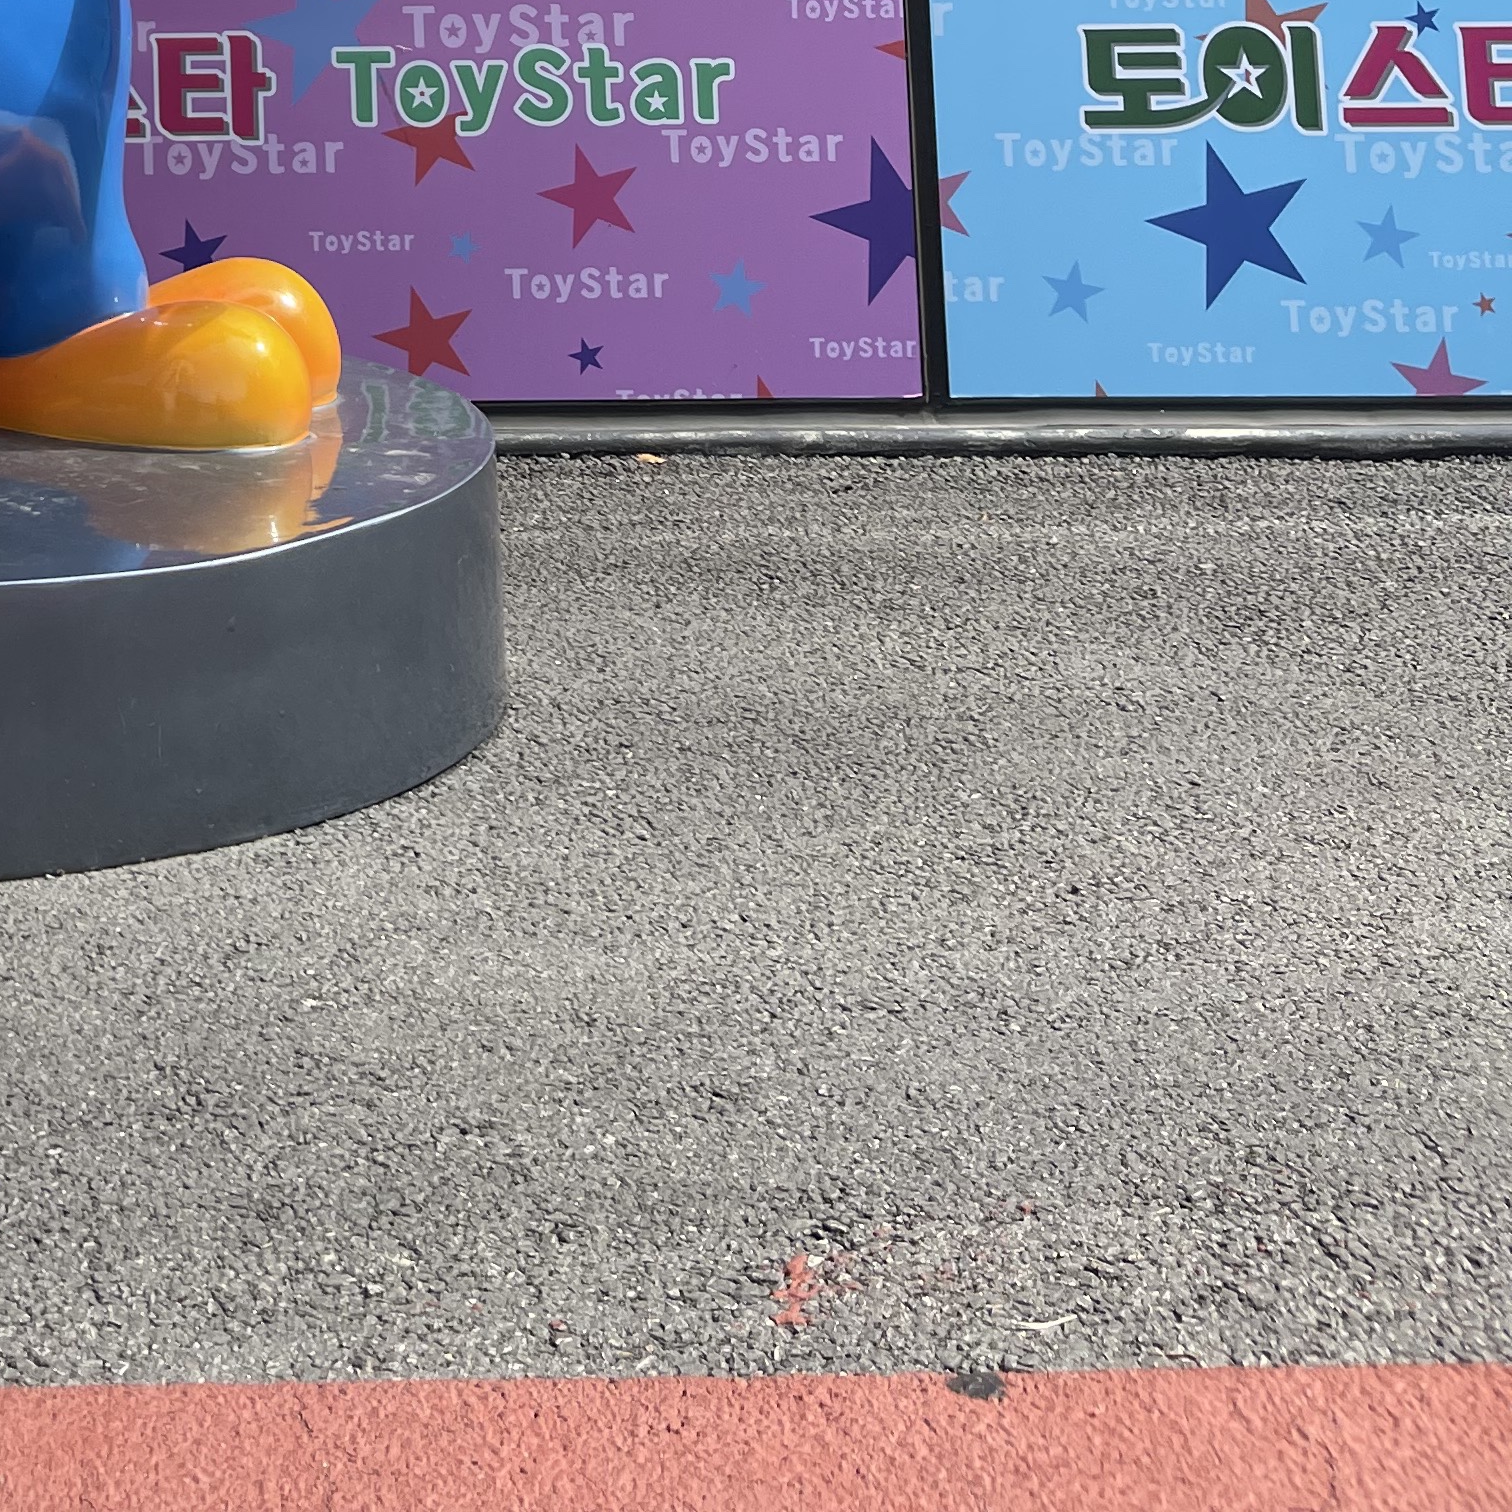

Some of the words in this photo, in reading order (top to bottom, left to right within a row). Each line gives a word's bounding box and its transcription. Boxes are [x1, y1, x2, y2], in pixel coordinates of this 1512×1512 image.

[403, 2, 636, 55] ToyStar
[331, 42, 736, 138] ToyStar
[141, 133, 345, 181] ToyStar
[660, 126, 845, 168] ToyStar
[994, 132, 1180, 173] ToyStar
[308, 229, 415, 257] ToyStar
[503, 267, 669, 304] ToyStar
[1280, 298, 1460, 336] ToyStar
[809, 337, 917, 361] ToyStar
[1147, 341, 1256, 366] ToyStar
